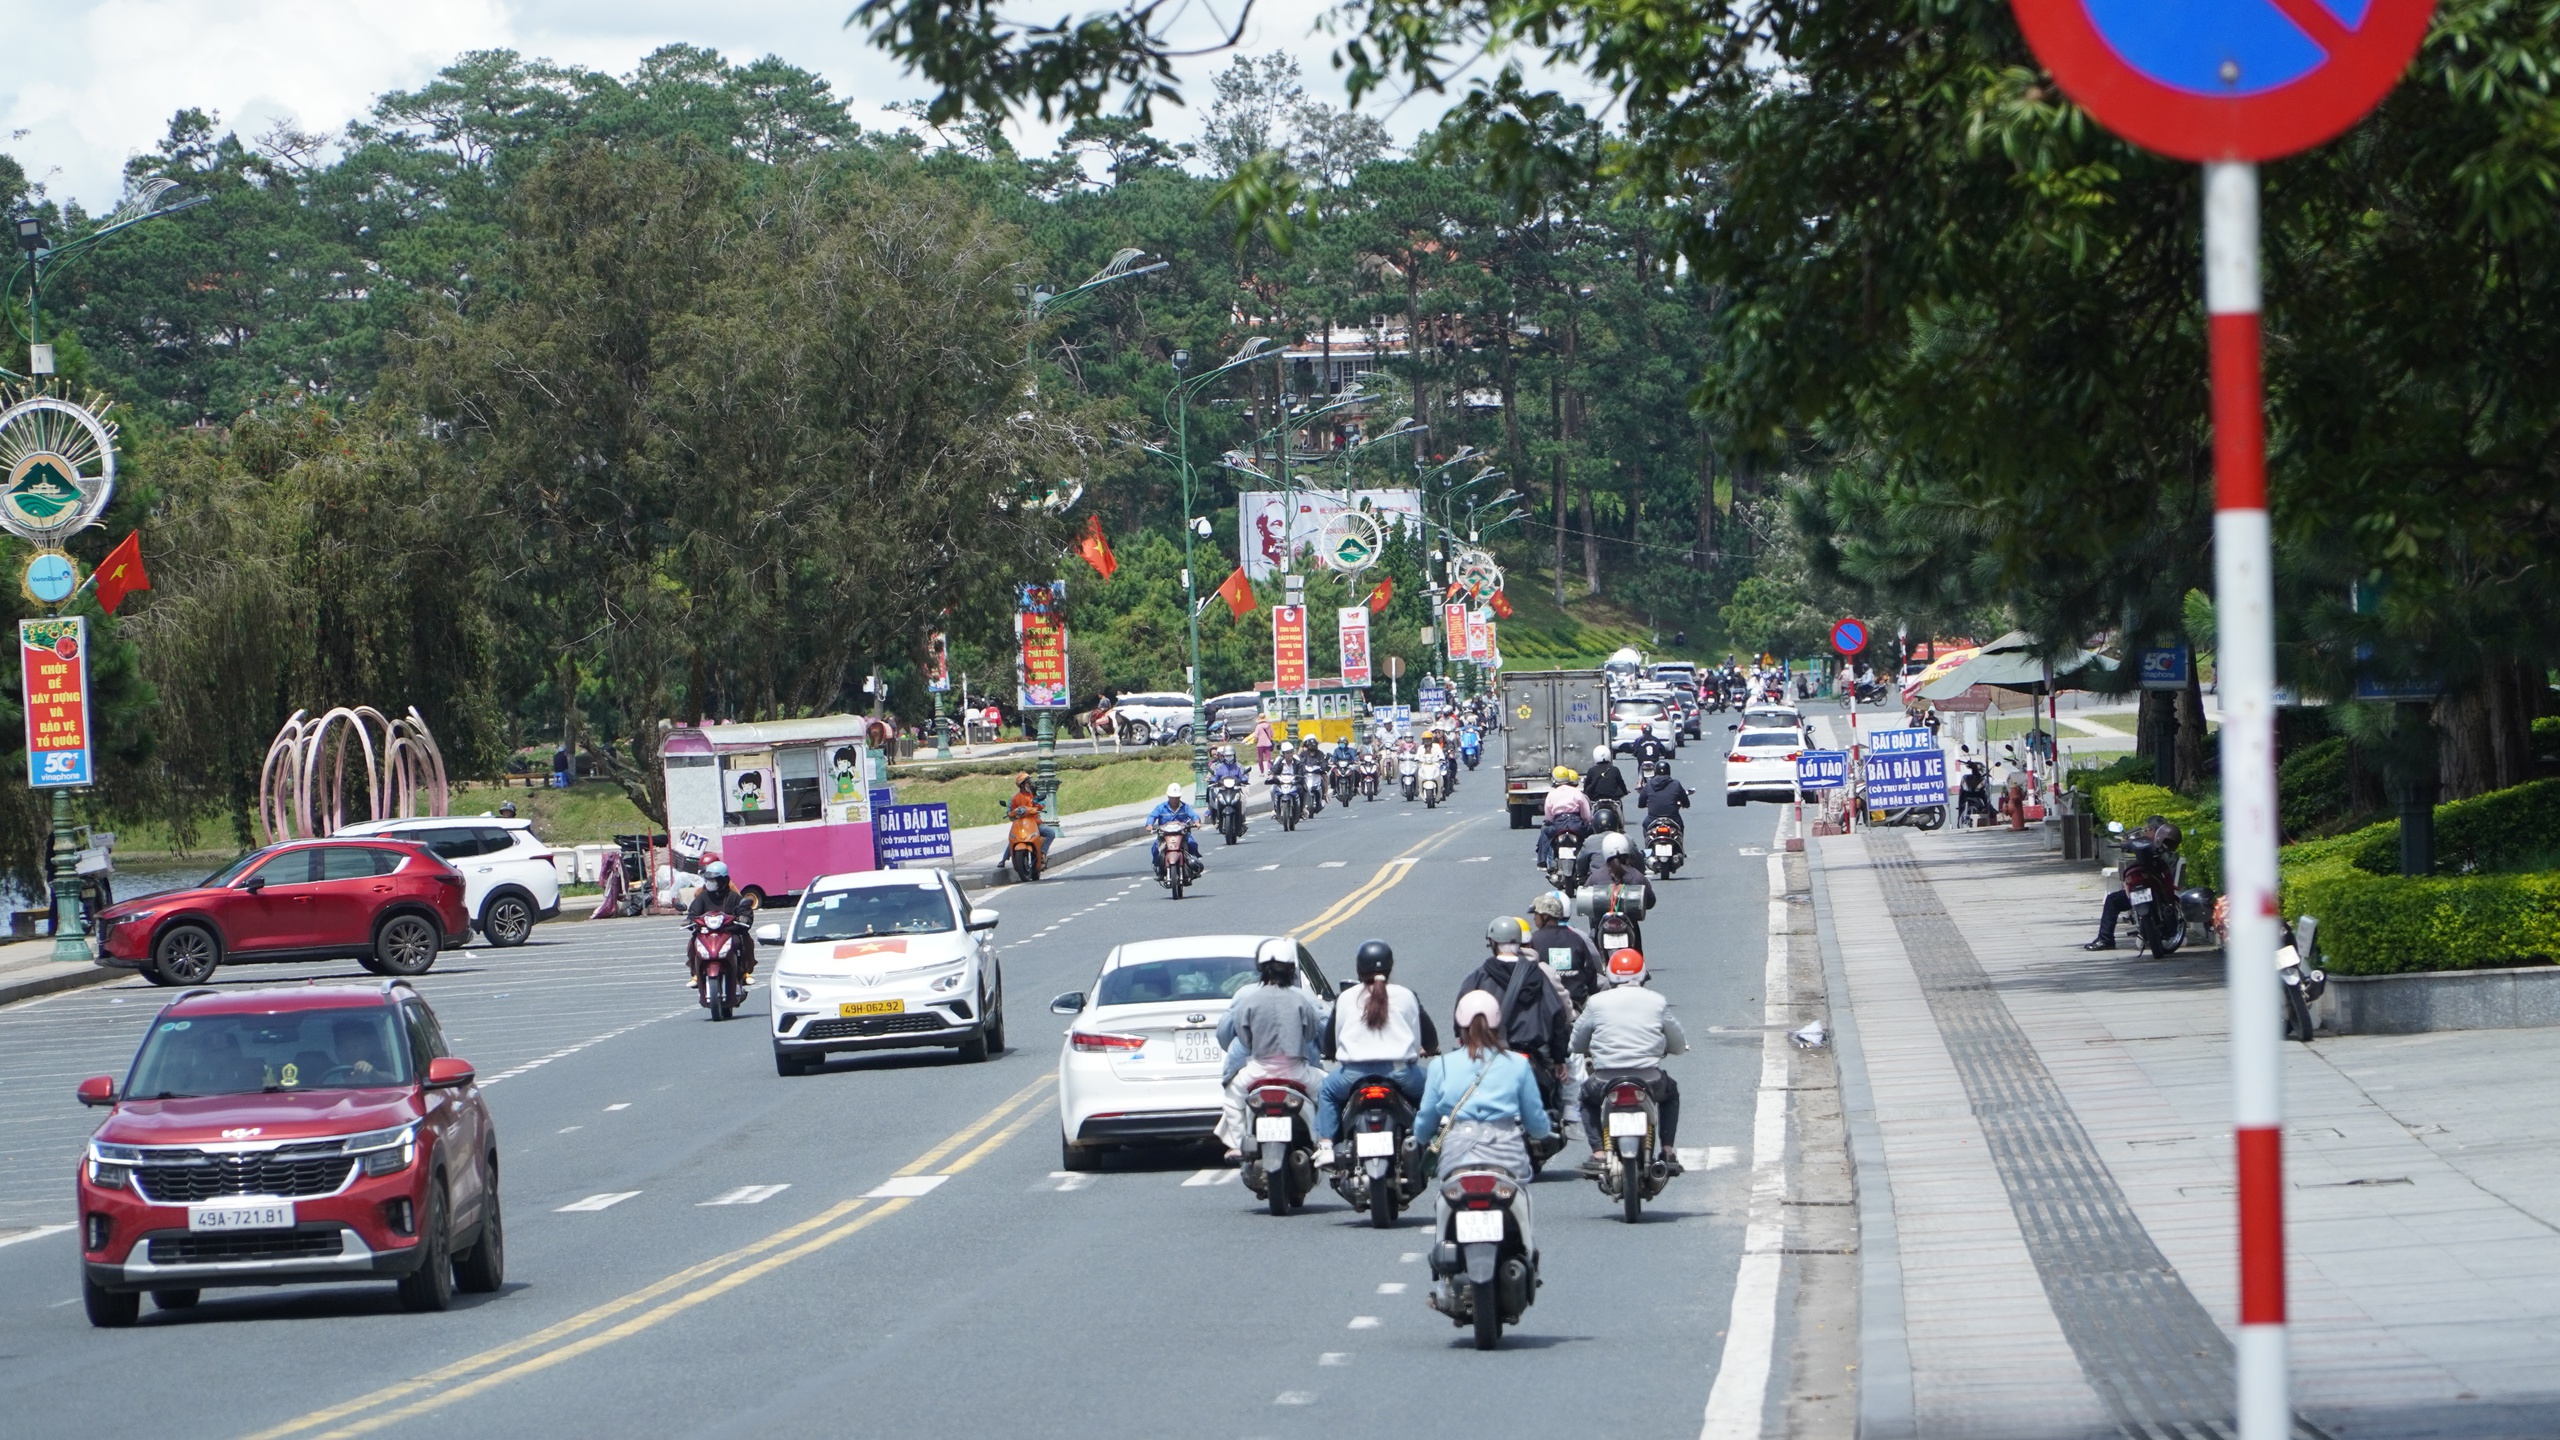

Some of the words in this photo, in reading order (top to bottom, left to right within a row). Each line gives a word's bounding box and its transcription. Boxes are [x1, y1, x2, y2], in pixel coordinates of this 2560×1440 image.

[40, 662, 68, 675] KHỎE
[48, 676, 62, 690] ĐỂ
[31, 692, 50, 704] XÂY
[52, 692, 80, 704] DỰNG
[50, 706, 64, 718] VÀ
[1571, 702, 1590, 712] 49C
[40, 720, 60, 733] BẢO
[62, 720, 76, 733] VỆ
[52, 733, 80, 748] QUỐC
[1872, 732, 1890, 750] BÃI
[1892, 732, 1914, 752] ĐẬU
[1914, 732, 1928, 748] XE
[1800, 758, 1818, 778] LỐI
[1820, 760, 1843, 777] VÀO
[1868, 760, 1890, 781] BÃI
[1894, 758, 1921, 782] ĐẬU
[1924, 758, 1942, 776] XE
[40, 772, 80, 782] vinaphone
[880, 810, 900, 832] BÃI
[903, 808, 928, 833] ĐẬU
[930, 809, 947, 828] XE
[844, 1001, 899, 1014] 49H-062.92
[1186, 1032, 1209, 1046] 60A
[198, 1209, 283, 1226] 49A-721.81
